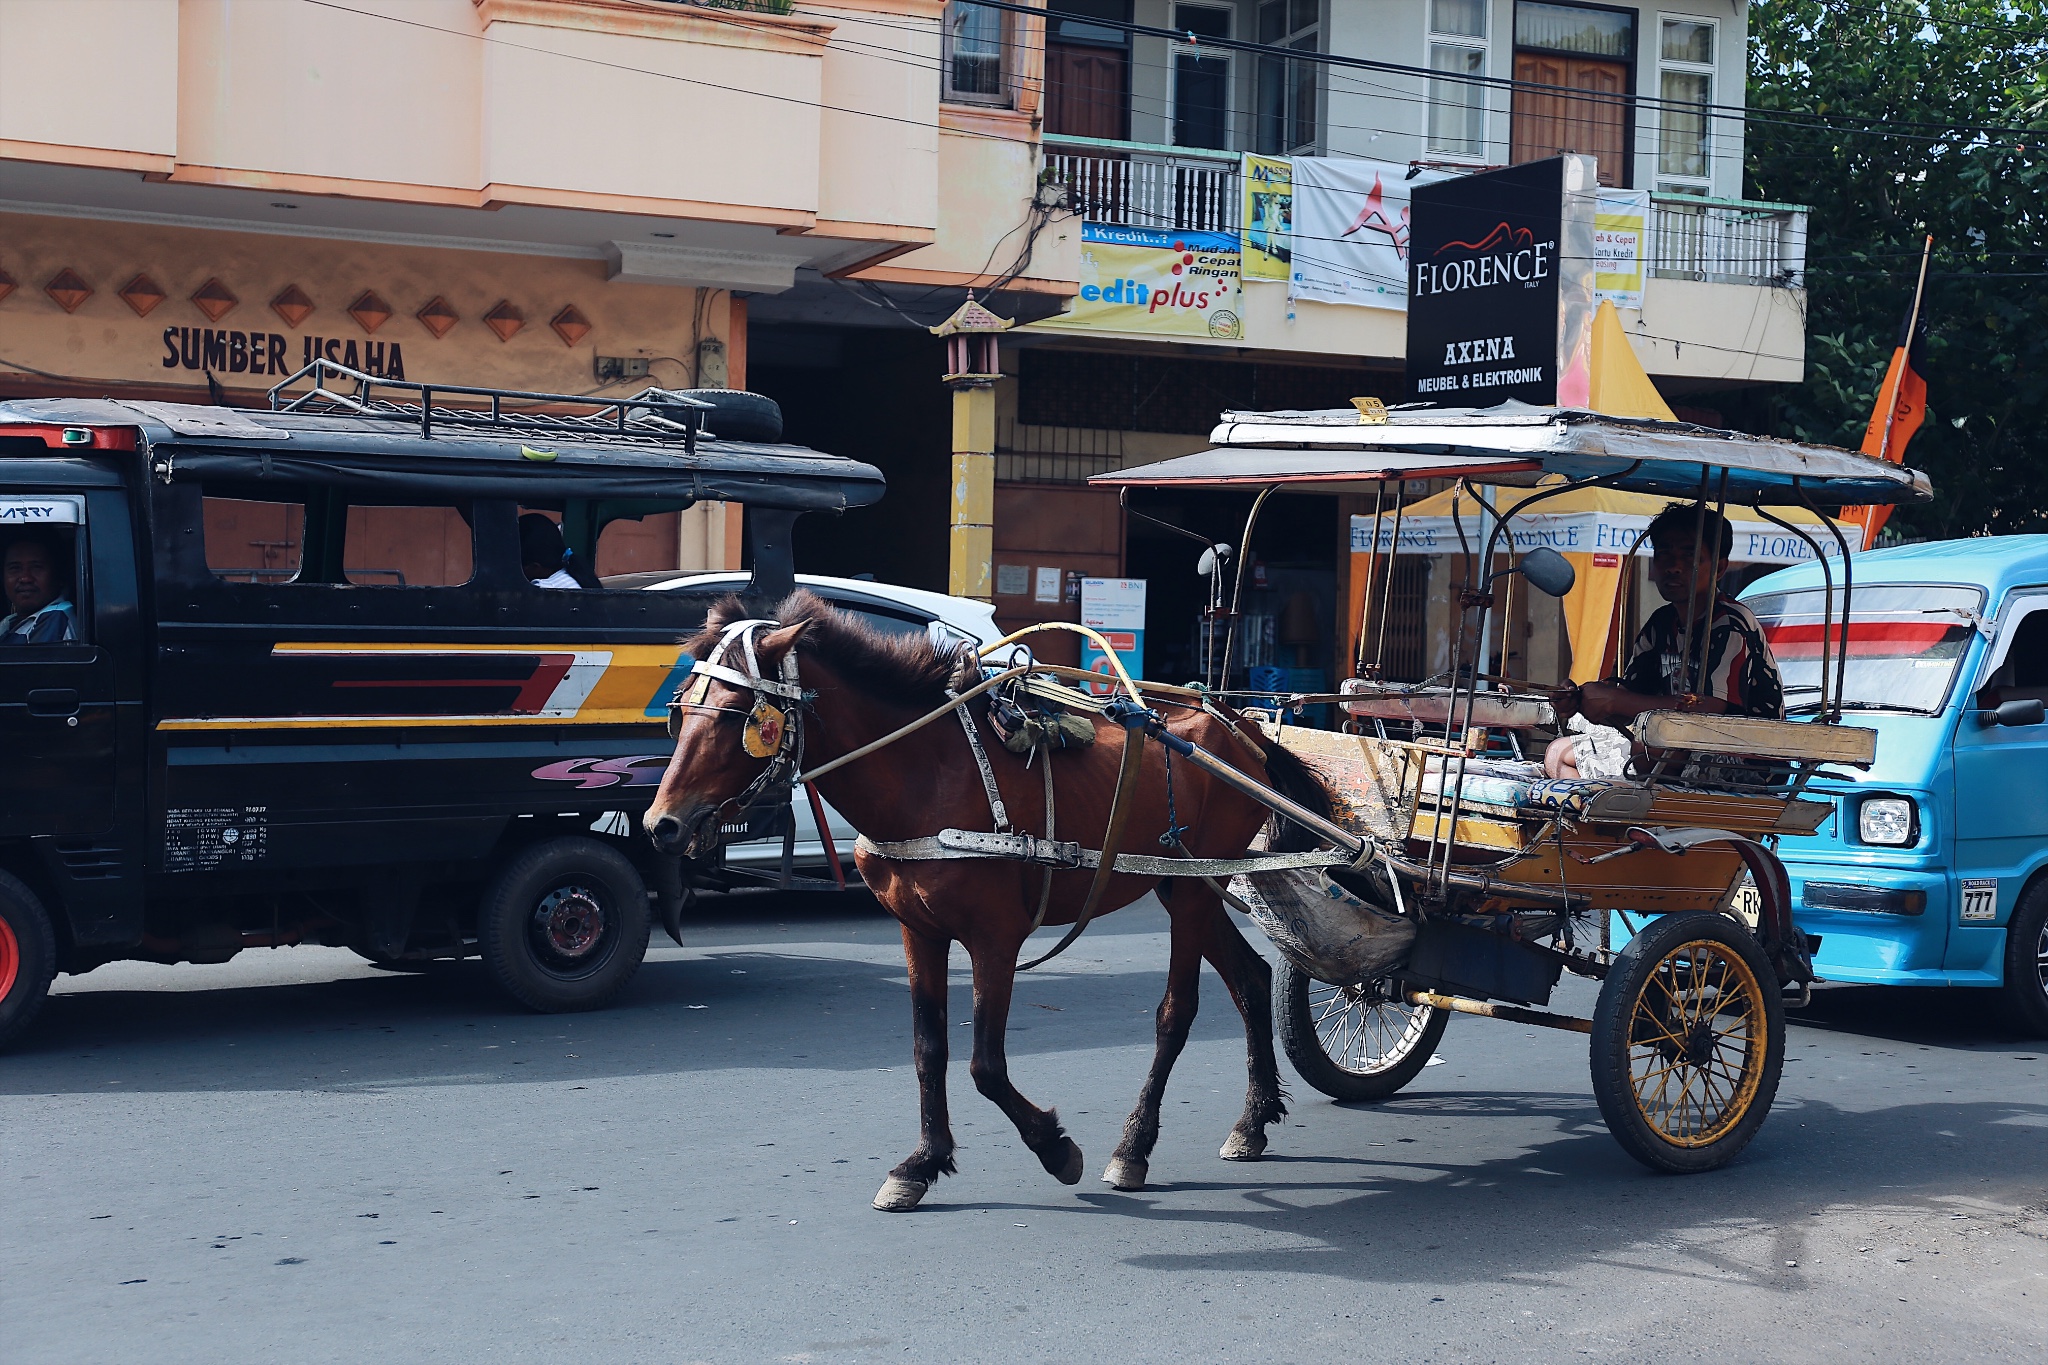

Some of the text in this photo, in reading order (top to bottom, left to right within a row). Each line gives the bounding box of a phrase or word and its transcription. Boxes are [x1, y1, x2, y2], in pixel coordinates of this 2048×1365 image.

[1095, 228, 1168, 244] Kredit..?
[1606, 234, 1613, 243] &
[1615, 235, 1636, 246] Cepat
[1188, 244, 1236, 254] Mudah
[1613, 247, 1634, 259] Kredit
[1198, 256, 1241, 266] Cepat
[1596, 260, 1617, 270] easing
[1189, 266, 1239, 278] Ringan
[1416, 242, 1548, 296] FLORENCE
[1524, 280, 1539, 288] ITALY
[163, 326, 406, 382] SUMBER USAHA
[1443, 336, 1516, 366] AXENA
[1418, 367, 1542, 392] MEUBEL & ELEKTRONIK
[0, 507, 53, 518] ARRY
[1128, 582, 1143, 590] BNI
[1964, 890, 1993, 913] 777
